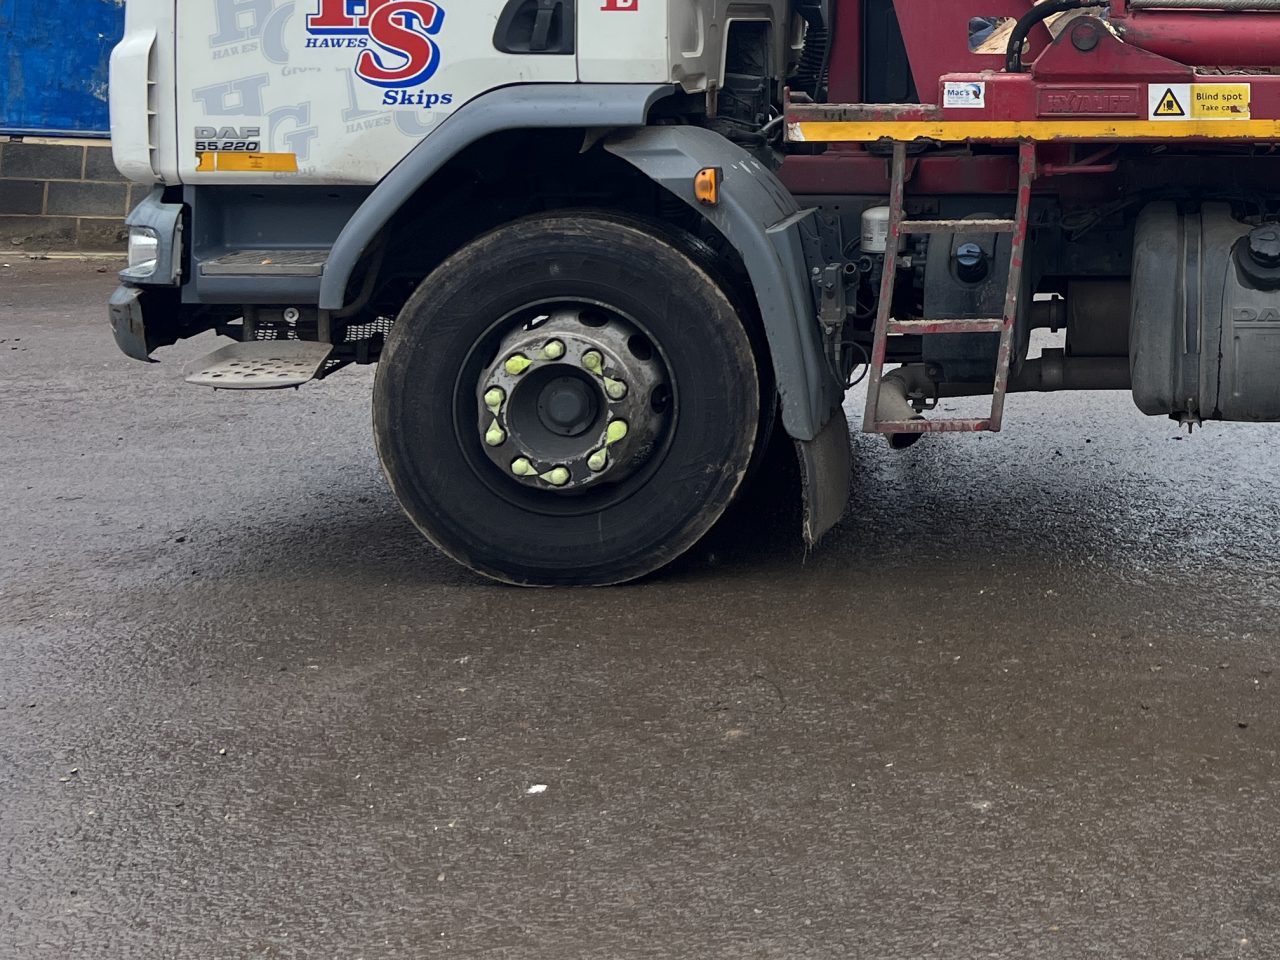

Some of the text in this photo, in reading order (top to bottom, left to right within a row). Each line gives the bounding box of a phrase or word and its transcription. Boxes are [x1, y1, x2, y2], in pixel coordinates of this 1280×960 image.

[305, 38, 368, 48] HAWES
[382, 89, 453, 109] Skips
[1196, 92, 1243, 102] Blind spot
[194, 126, 260, 140] DAF
[195, 141, 258, 151] 55.220
